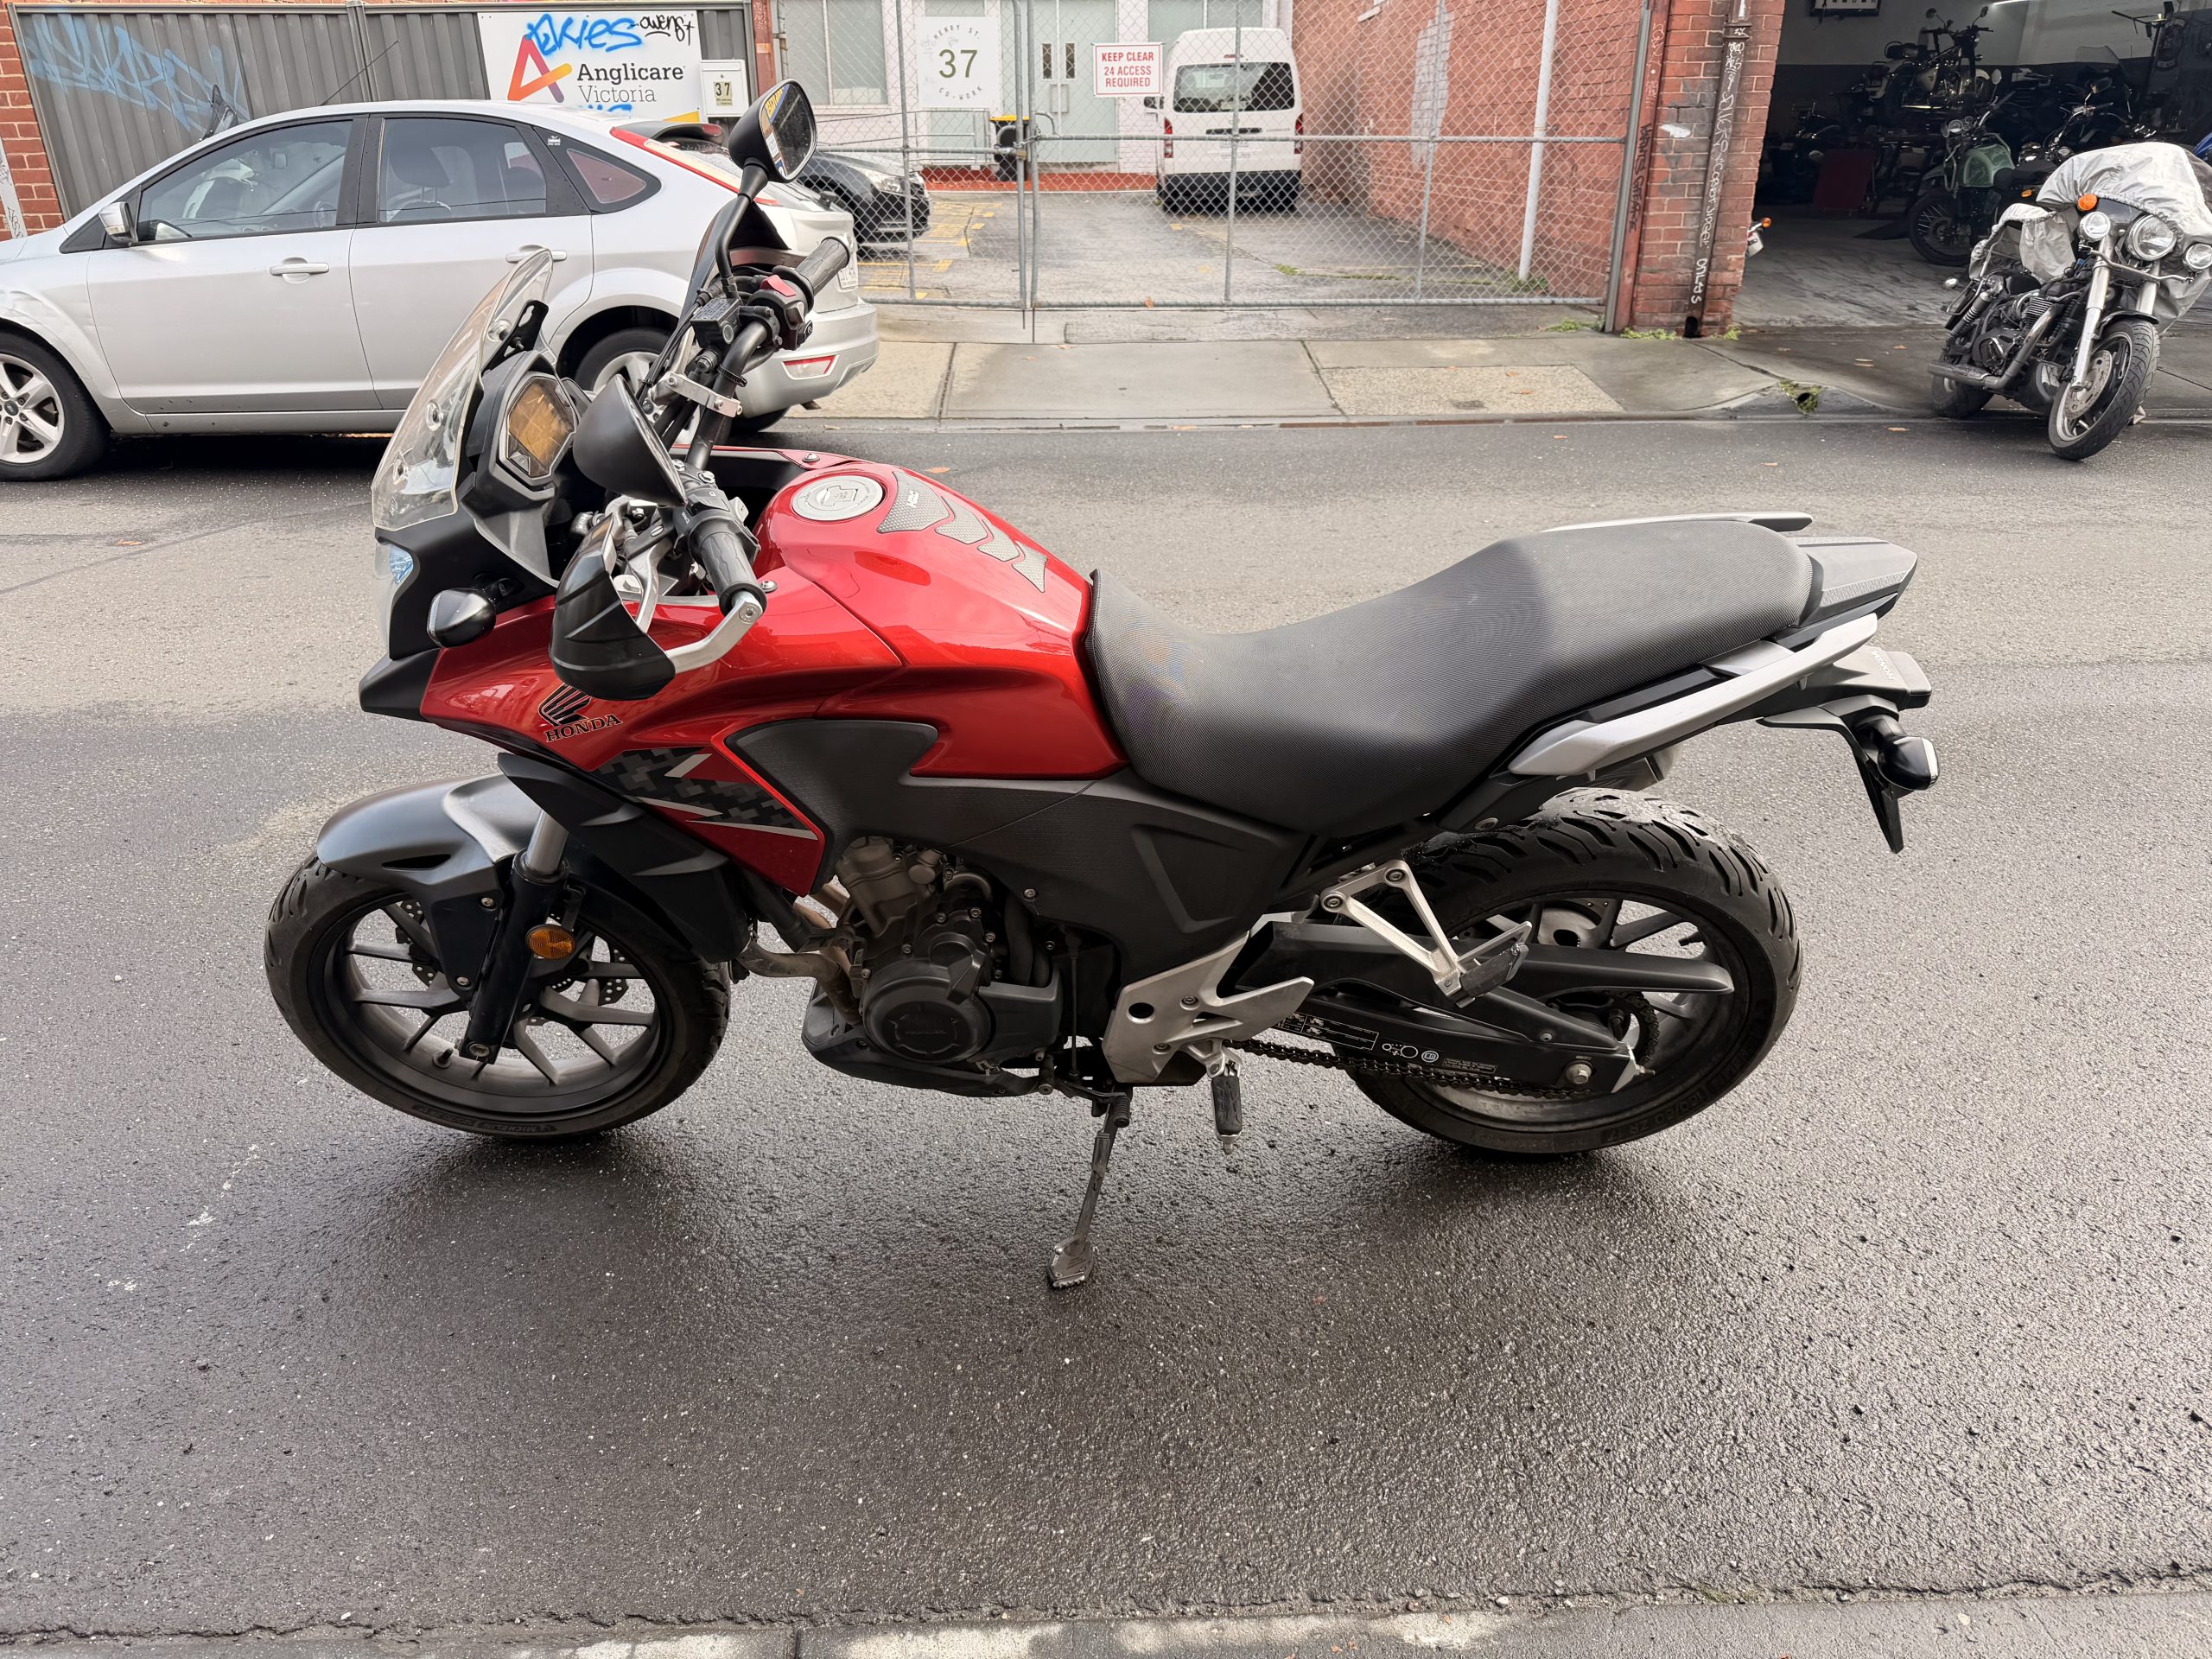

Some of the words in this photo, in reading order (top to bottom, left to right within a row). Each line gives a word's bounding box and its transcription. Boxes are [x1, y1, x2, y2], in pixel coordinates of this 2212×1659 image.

[939, 49, 977, 78] 37
[1102, 52, 1123, 61] KEEP
[1127, 52, 1154, 61] CLEAR
[577, 63, 683, 85] Anglicare
[1104, 66, 1115, 76] 24
[1117, 66, 1152, 76] ACCESS
[715, 82, 730, 96] 37
[1106, 77, 1151, 87] REQUIRED
[578, 85, 657, 103] Victoria
[544, 713, 623, 743] HONDA
